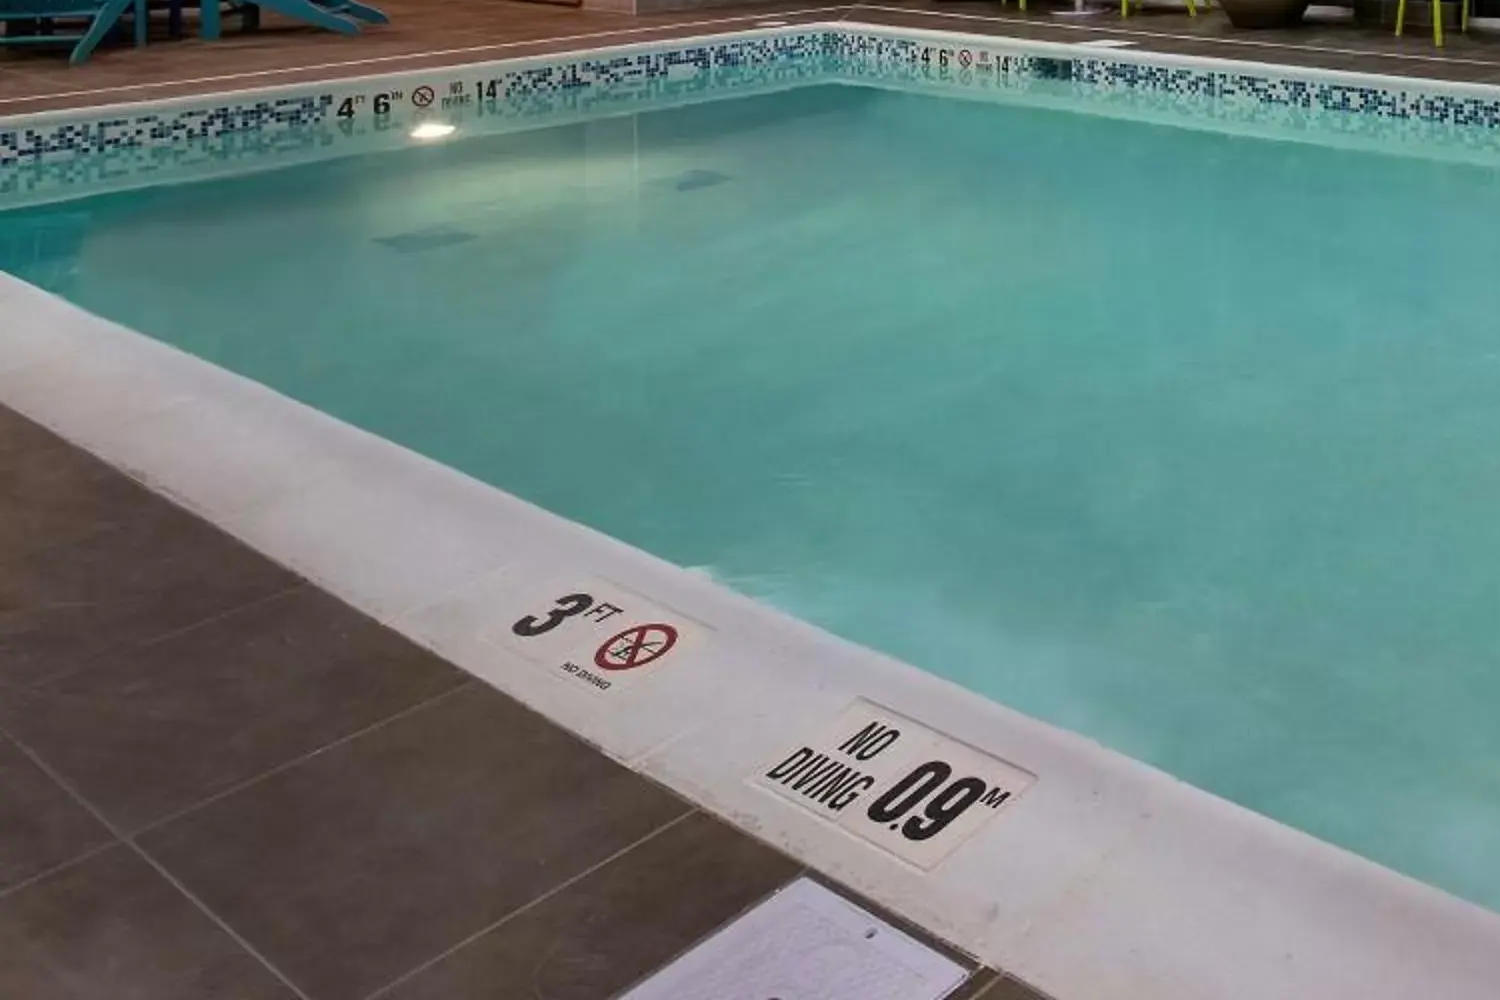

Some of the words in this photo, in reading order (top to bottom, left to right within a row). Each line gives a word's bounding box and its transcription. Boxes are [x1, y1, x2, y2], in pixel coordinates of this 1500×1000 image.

[560, 661, 580, 673] NO
[575, 669, 612, 691] DIVING
[838, 721, 901, 761] NO
[766, 746, 875, 812] DIVING
